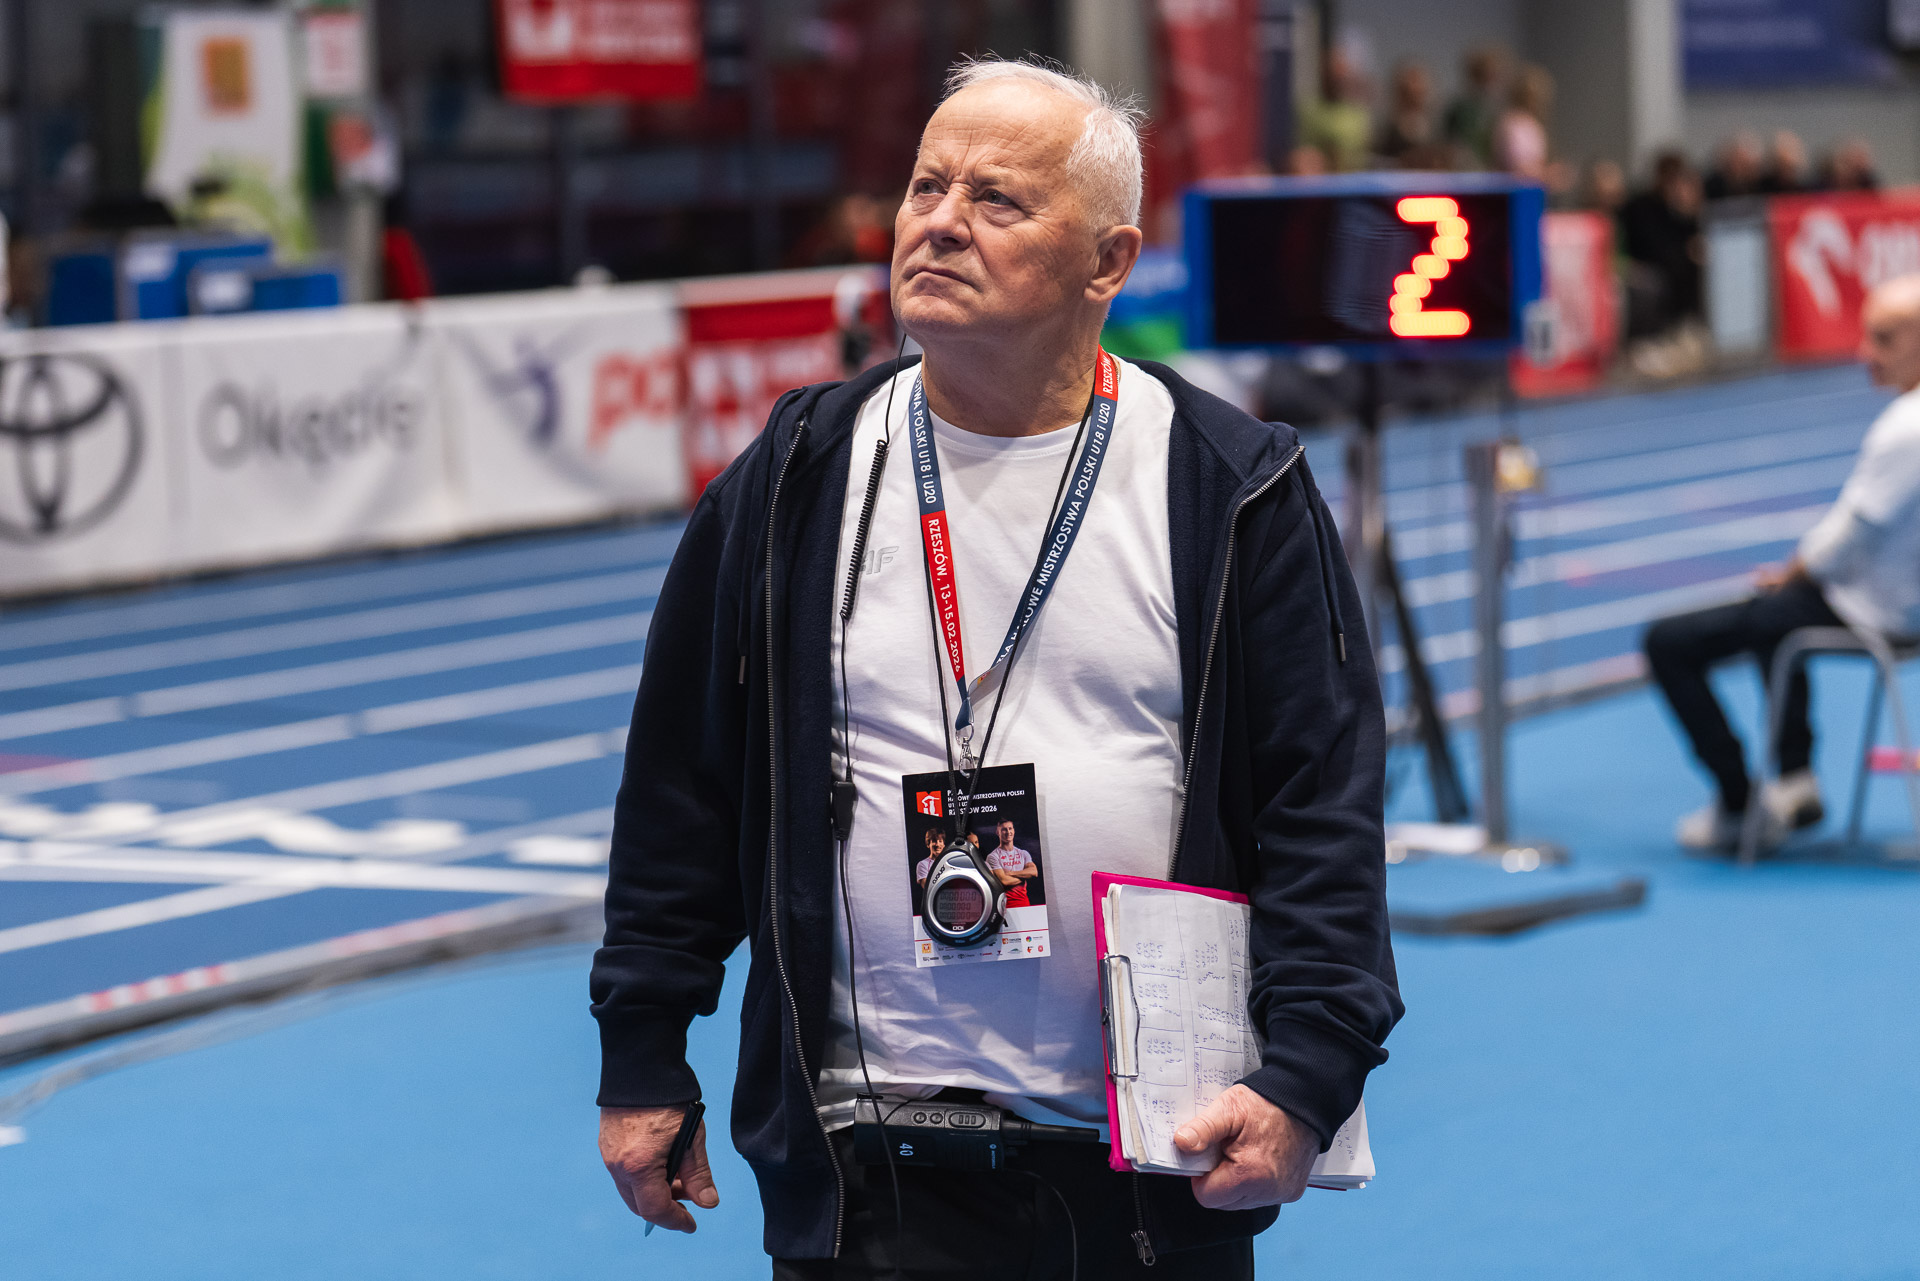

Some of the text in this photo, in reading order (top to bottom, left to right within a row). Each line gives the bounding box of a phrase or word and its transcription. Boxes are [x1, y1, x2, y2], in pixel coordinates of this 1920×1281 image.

[1391, 197, 1469, 337] 2
[914, 411, 927, 449] POLSKI
[918, 450, 932, 472] U18
[923, 480, 937, 504] U20
[1036, 499, 1082, 586] MISTRZOSTWA
[1075, 456, 1098, 499] POLSKI
[1091, 432, 1104, 455] U18
[1098, 403, 1111, 426] U20
[940, 584, 961, 672] 13-15.02.2026
[981, 805, 998, 813] 2026
[899, 1143, 913, 1156] 40
